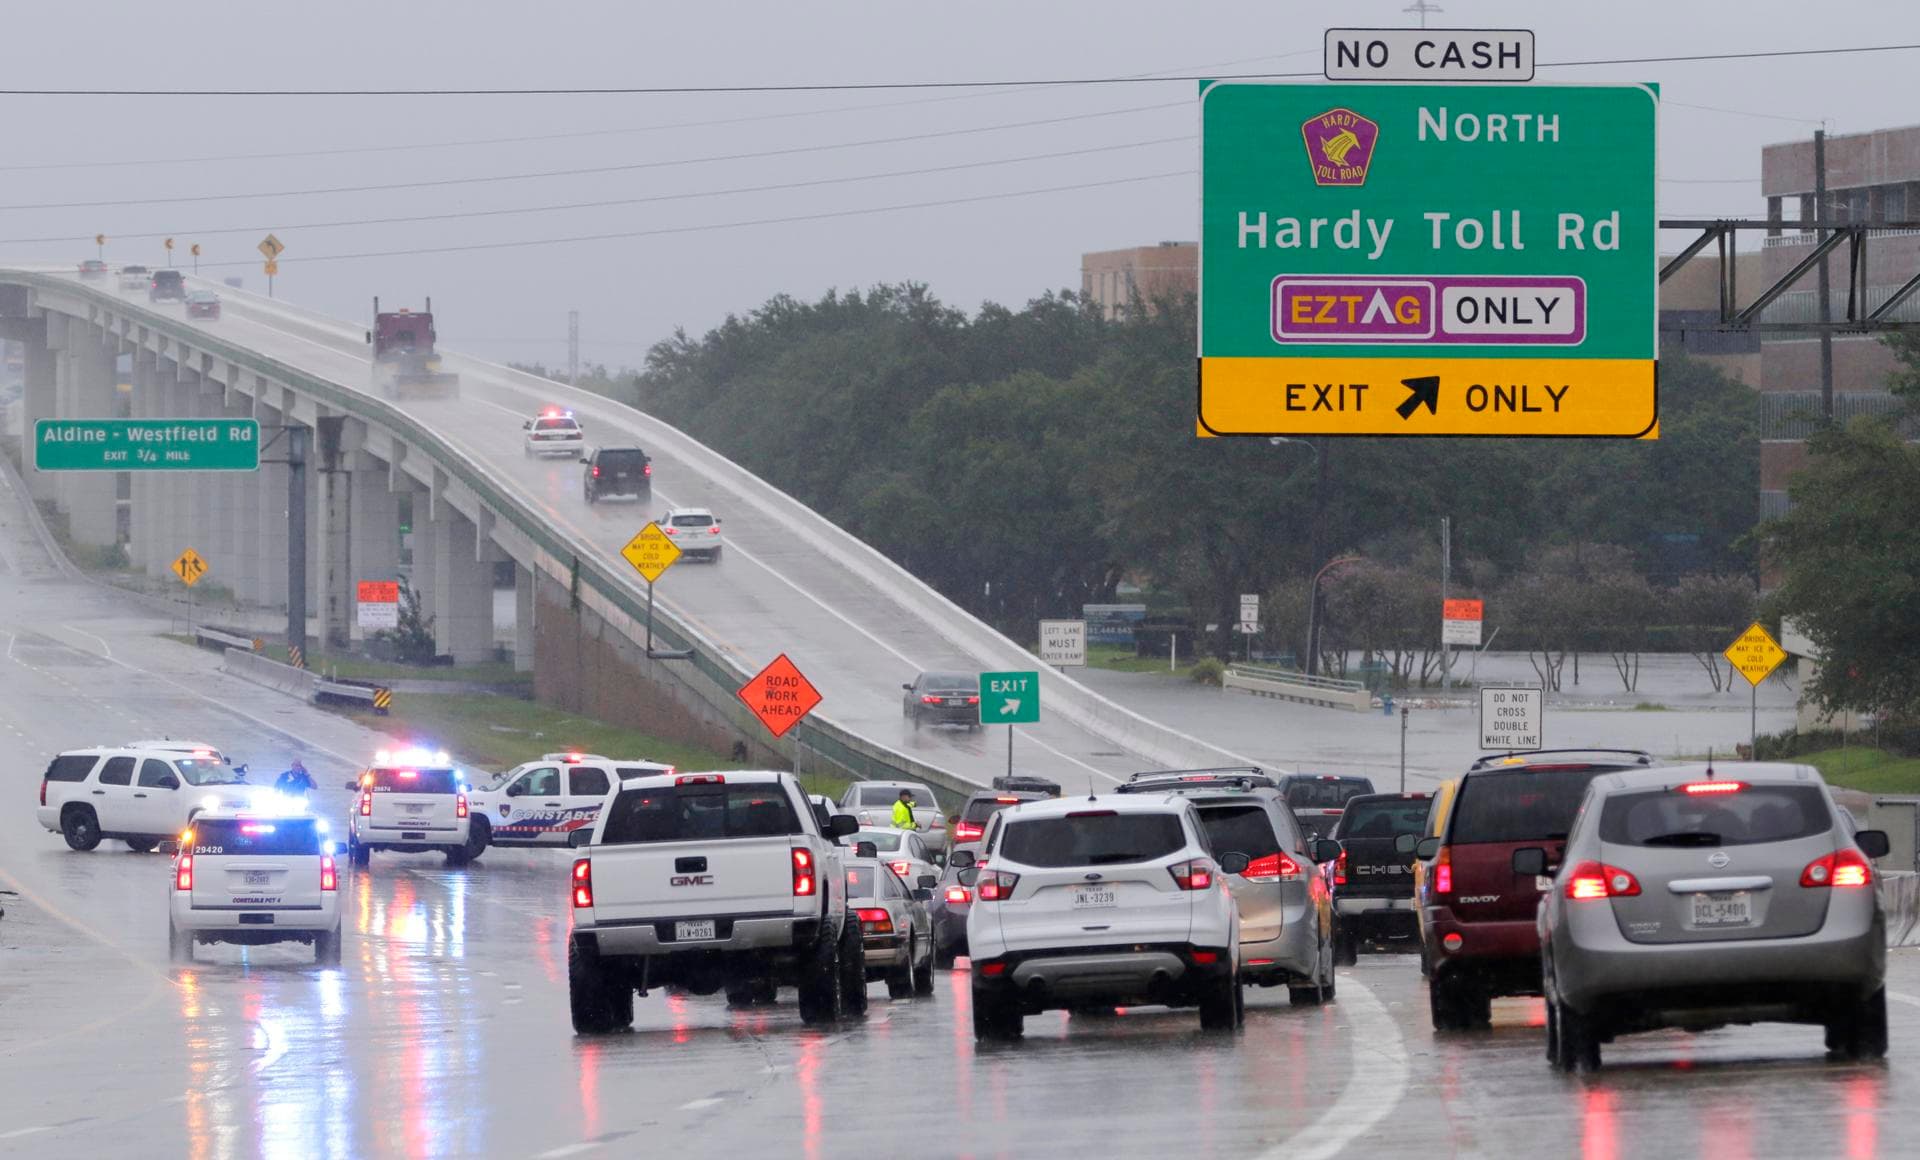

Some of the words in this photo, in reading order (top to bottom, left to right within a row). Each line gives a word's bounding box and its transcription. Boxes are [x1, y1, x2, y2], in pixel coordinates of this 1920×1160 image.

[1336, 41, 1389, 69] NO
[1413, 41, 1522, 69] CASH
[1321, 114, 1358, 128] HARDY
[1418, 107, 1560, 142] NORTH
[1317, 165, 1337, 180] TOLL
[1341, 165, 1363, 180] ROAD
[1238, 210, 1395, 260] Hardy
[1423, 210, 1525, 250] Toll
[1557, 210, 1621, 251] Rd
[1291, 288, 1421, 324] EZTAG
[1456, 296, 1560, 325] ONLY
[1286, 384, 1369, 411] EXIT
[1465, 385, 1570, 412] ONLY
[44, 427, 106, 442] Aldine
[127, 427, 217, 442] Westfield
[229, 427, 252, 442] Rd
[103, 451, 127, 461] EXIT
[166, 451, 191, 461] MILE
[632, 543, 645, 551] MAY
[650, 543, 659, 551] ICE
[643, 552, 660, 560] COLD
[638, 562, 665, 570] WEATHER
[1044, 627, 1060, 635] LEFT
[1064, 627, 1081, 635] LANE
[1049, 639, 1077, 648] MUST
[1754, 645, 1763, 653] ICE
[1043, 652, 1062, 660] ENTER
[1065, 652, 1082, 660] RAMP
[1747, 655, 1764, 663] COLD
[766, 676, 799, 687] ROAD
[991, 680, 1028, 692] EXIT
[765, 690, 798, 701] WORK
[1494, 694, 1506, 702] DO
[1512, 694, 1528, 702] NOT
[762, 705, 801, 716] AHEAD
[1497, 708, 1526, 717] CROSS
[1494, 722, 1528, 731] DOUBLE
[1485, 736, 1511, 744] WHITE
[1518, 736, 1537, 744] LINE
[512, 808, 601, 820] CONSTABLE
[196, 846, 223, 854] 29420
[1357, 865, 1416, 875] CHEV
[670, 875, 713, 886] GMC
[1460, 895, 1500, 904] ENVOY
